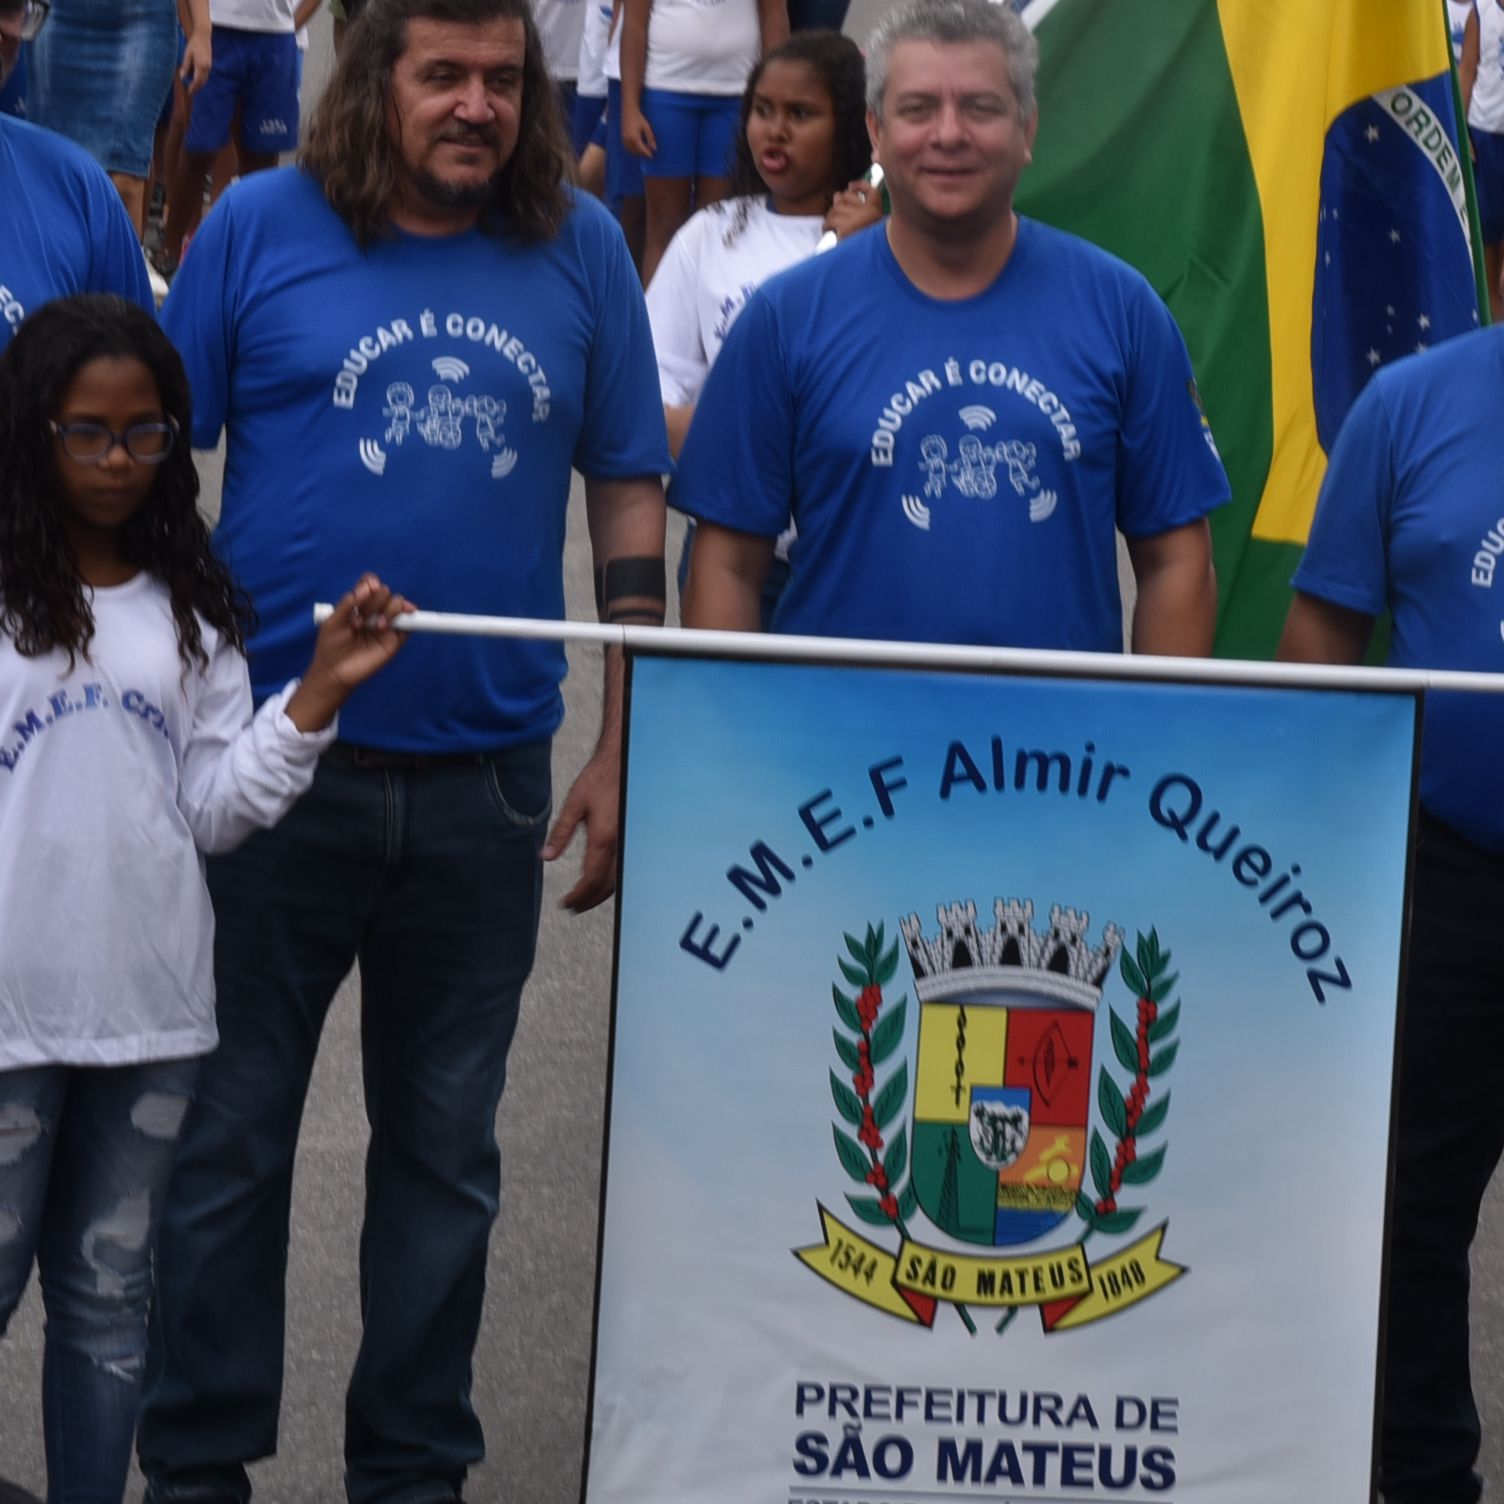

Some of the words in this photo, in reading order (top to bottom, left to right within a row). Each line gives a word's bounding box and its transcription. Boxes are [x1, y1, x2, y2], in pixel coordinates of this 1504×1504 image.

[333, 318, 414, 410] EDUCAR
[445, 312, 551, 423] CONECTAR
[870, 368, 943, 468] EDUCAR
[969, 359, 1081, 462] CONECTAR
[678, 756, 910, 972] E.M.E.F
[938, 734, 1131, 803] Almir
[1147, 772, 1353, 1007] Queiroz
[829, 1237, 879, 1288] 1544
[905, 1254, 957, 1293] SÃO
[975, 1256, 1084, 1297] MATEUS
[794, 1380, 1100, 1432] PREFEITURA
[1114, 1393, 1180, 1436] DE
[792, 1420, 915, 1482] SÃO
[936, 1434, 1178, 1491] MATEUS
